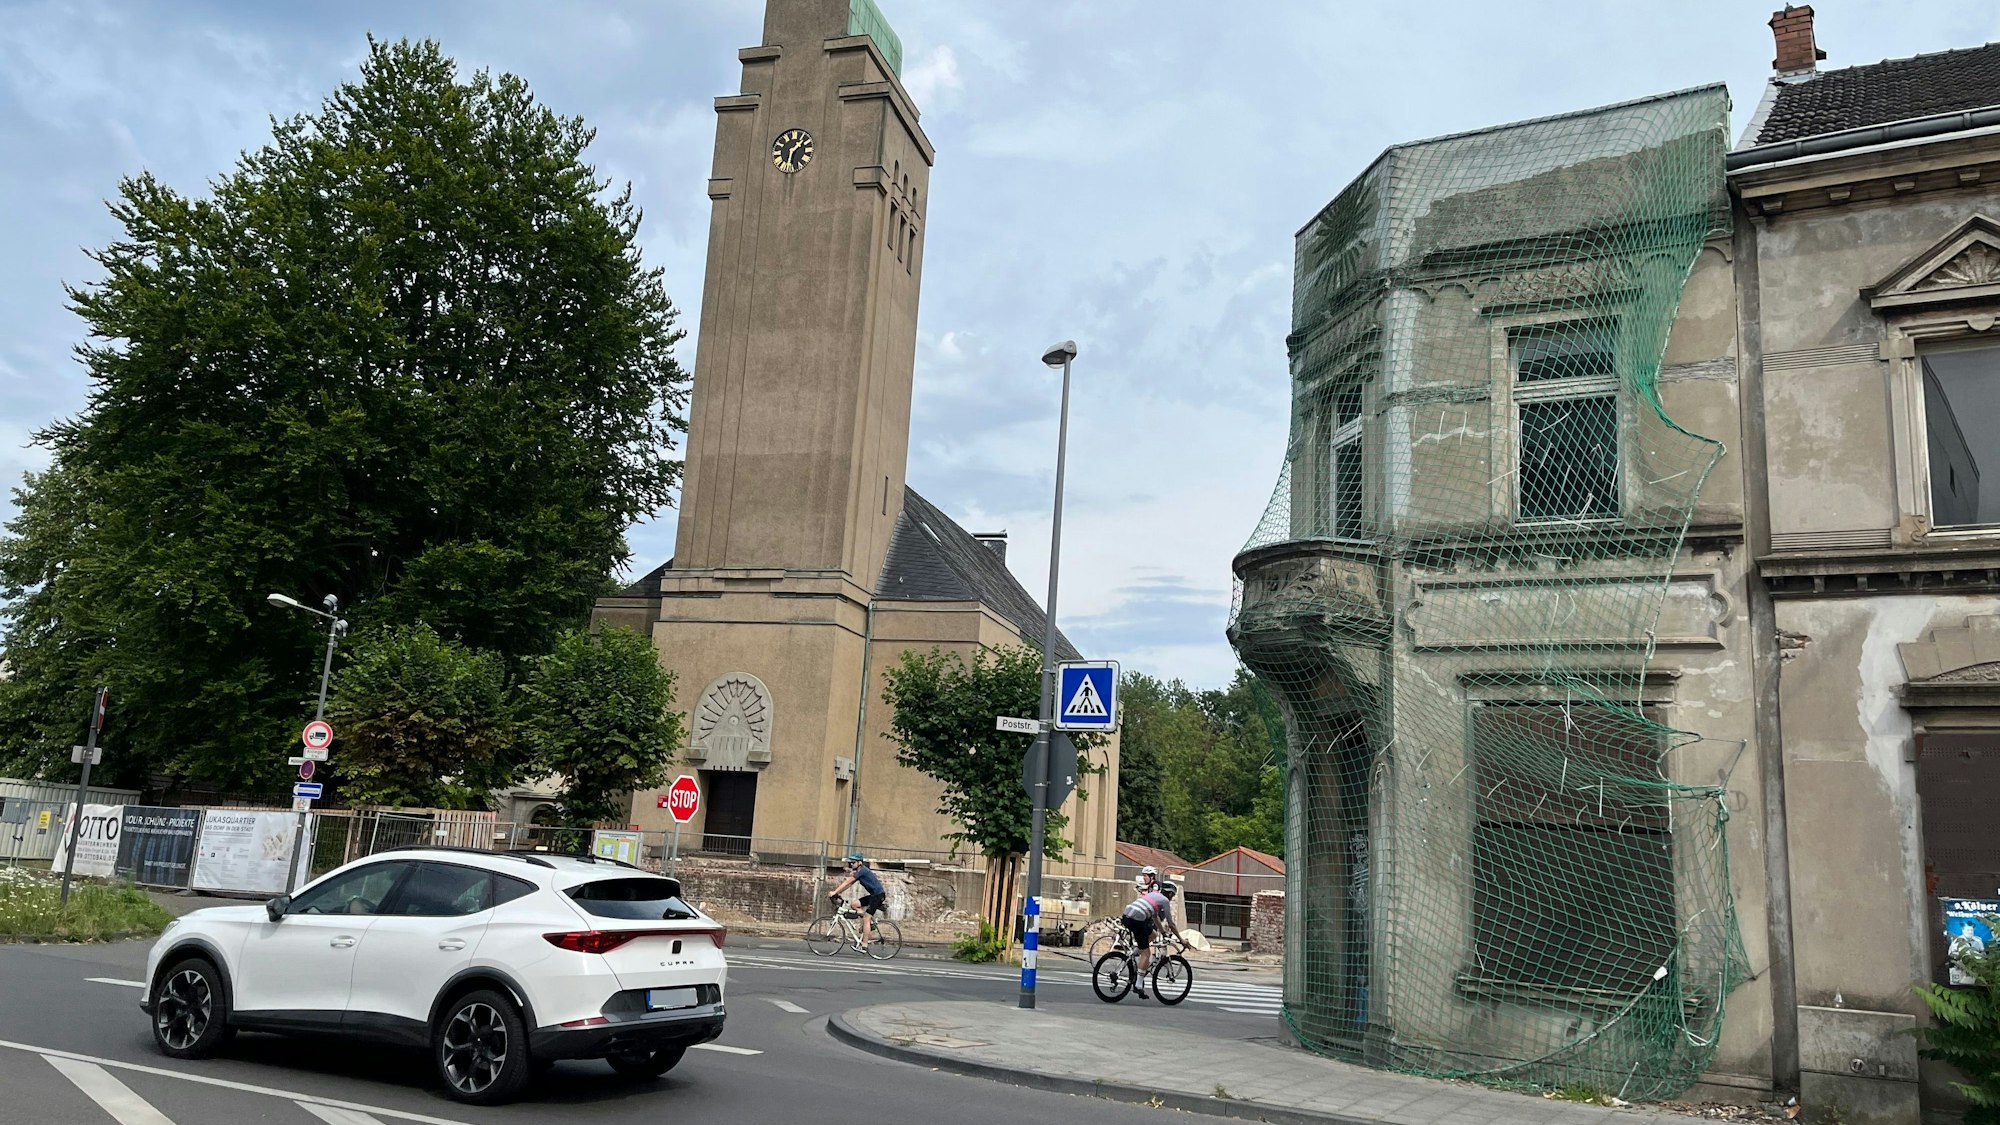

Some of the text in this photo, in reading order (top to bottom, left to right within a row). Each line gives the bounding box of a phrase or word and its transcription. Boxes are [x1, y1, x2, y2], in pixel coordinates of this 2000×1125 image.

[1002, 719, 1032, 730] Poststr.
[671, 789, 697, 808] STOP
[168, 818, 195, 828] PROJEKTE
[206, 815, 256, 825] LUKASQUARTIER
[78, 815, 119, 840] OTTO
[1962, 901, 1998, 911] Kölner
